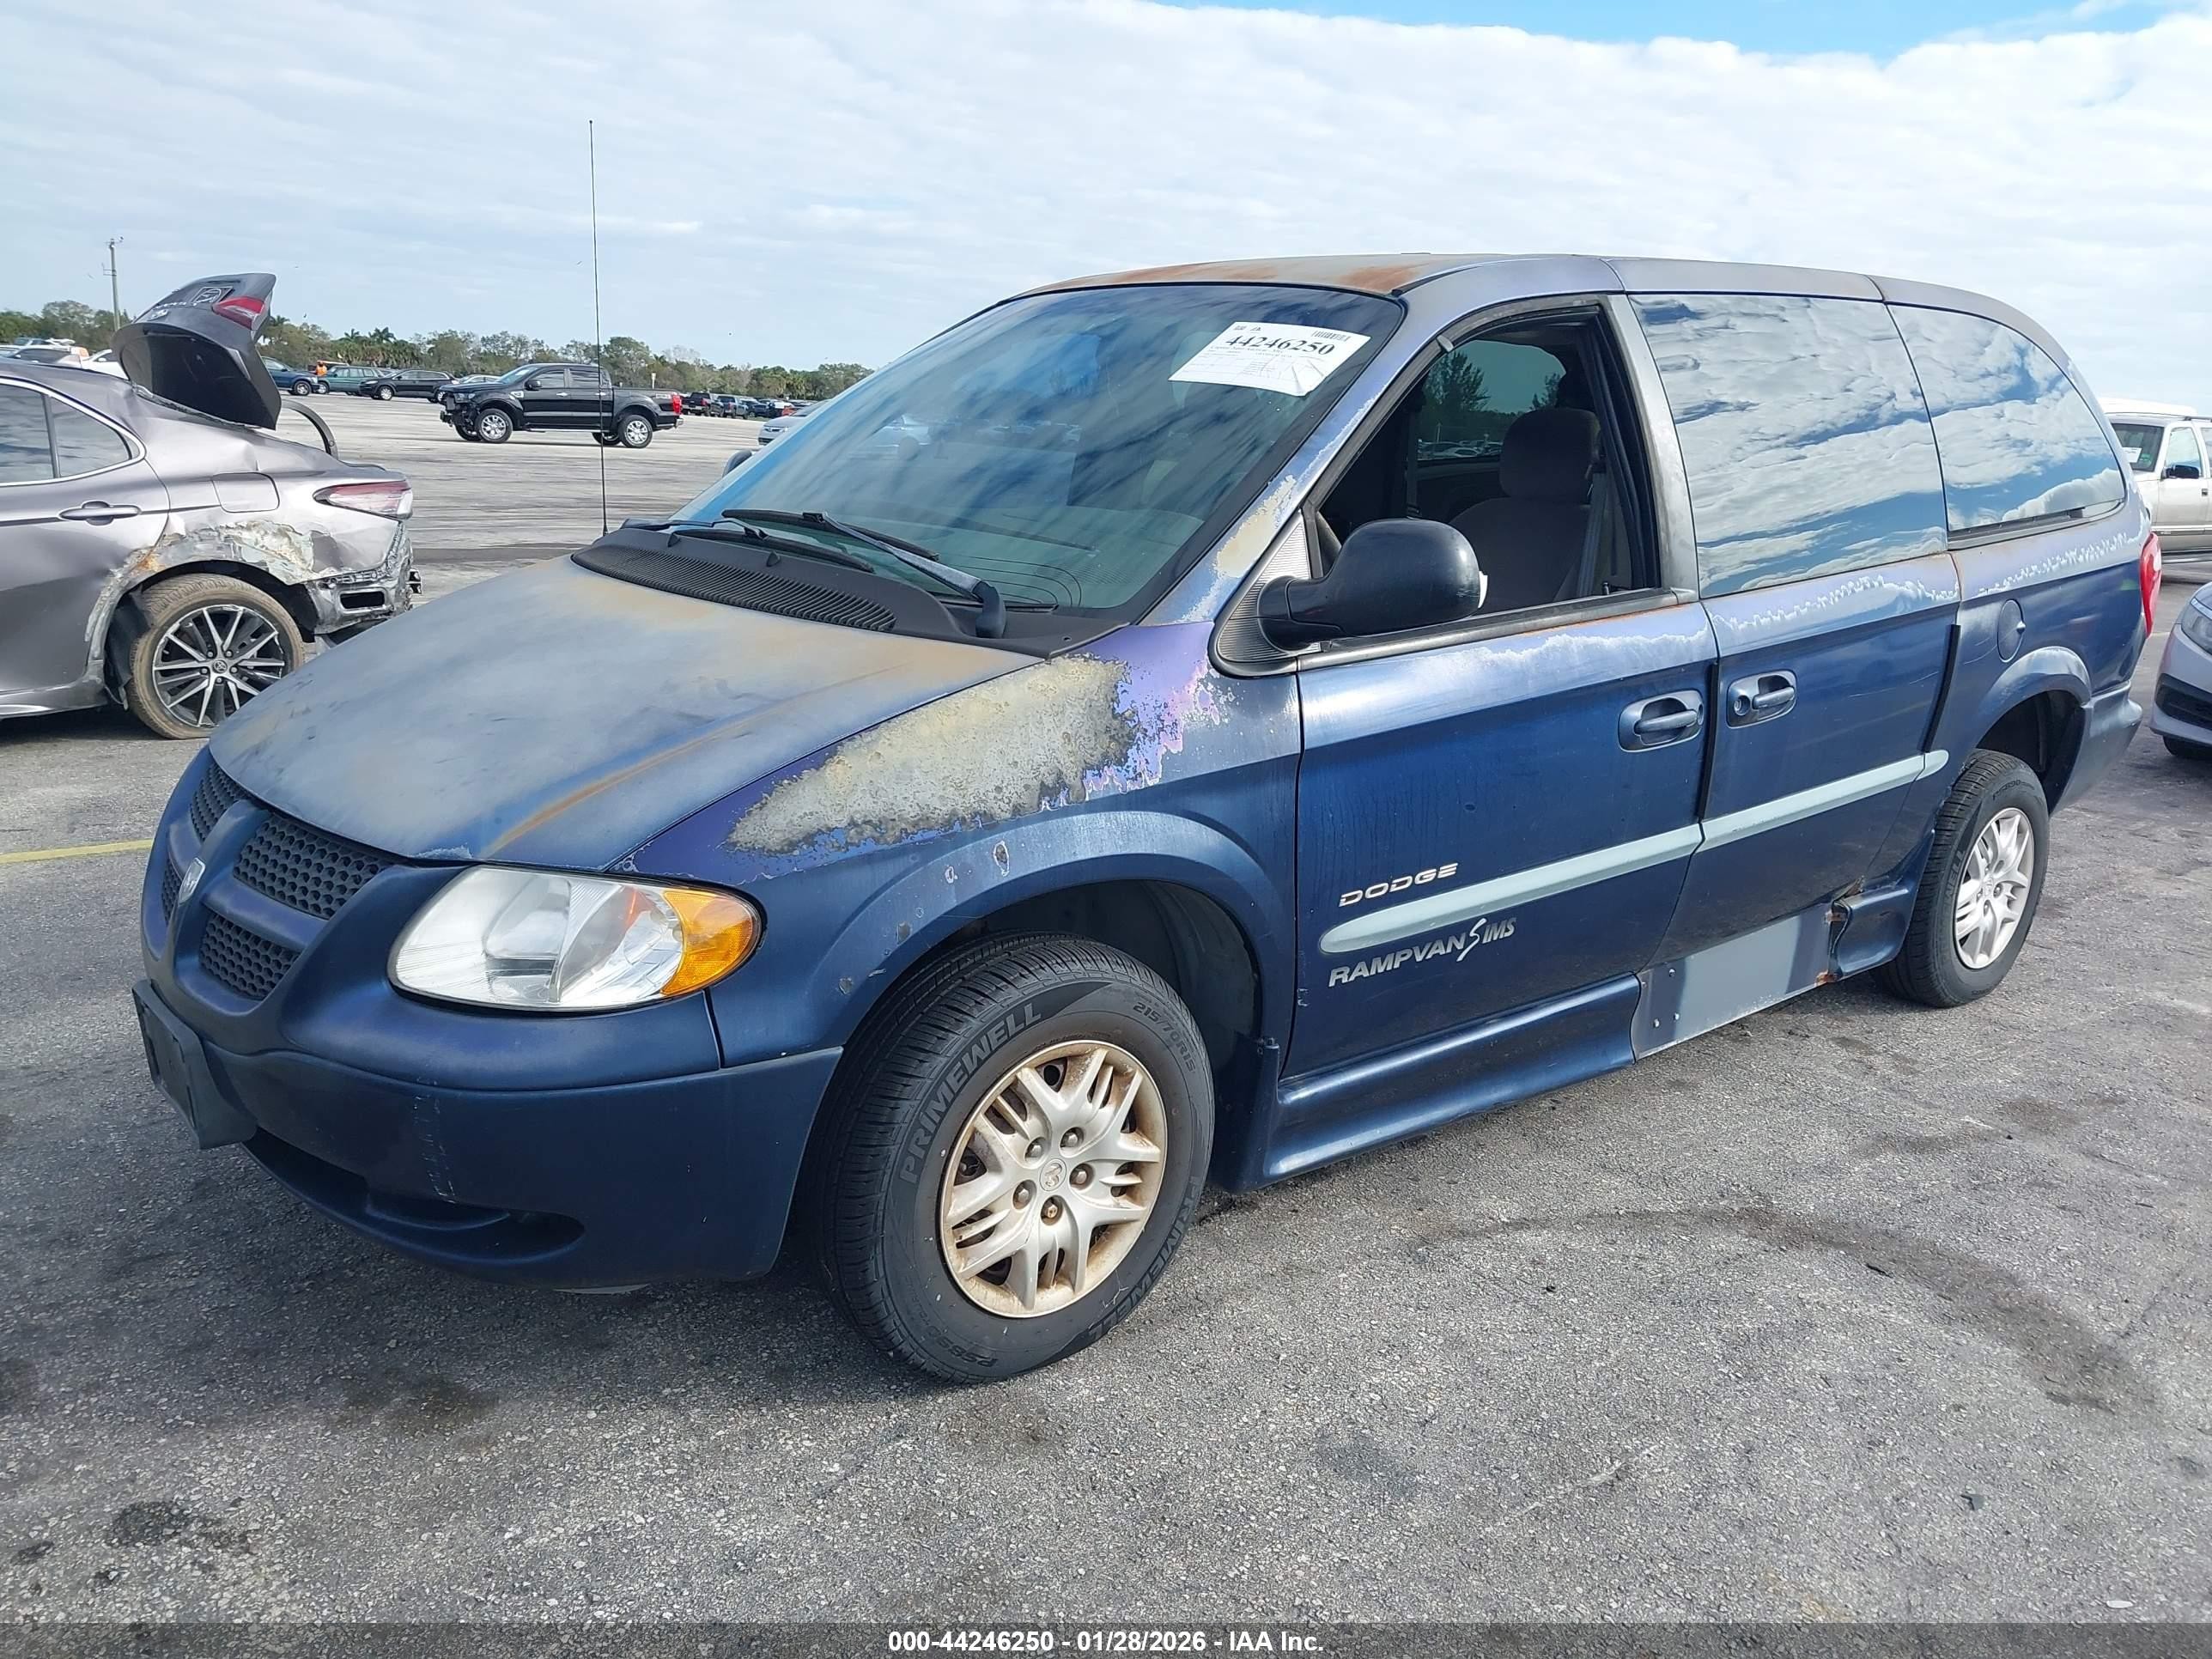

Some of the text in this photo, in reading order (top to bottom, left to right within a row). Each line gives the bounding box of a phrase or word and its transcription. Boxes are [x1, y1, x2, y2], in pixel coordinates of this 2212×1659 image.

[1225, 335, 1335, 356] 44246250
[1338, 862, 1459, 907] DODGE
[1133, 1002, 1197, 1073] 215/70R15
[899, 1003, 1044, 1183] PRIMEWELL
